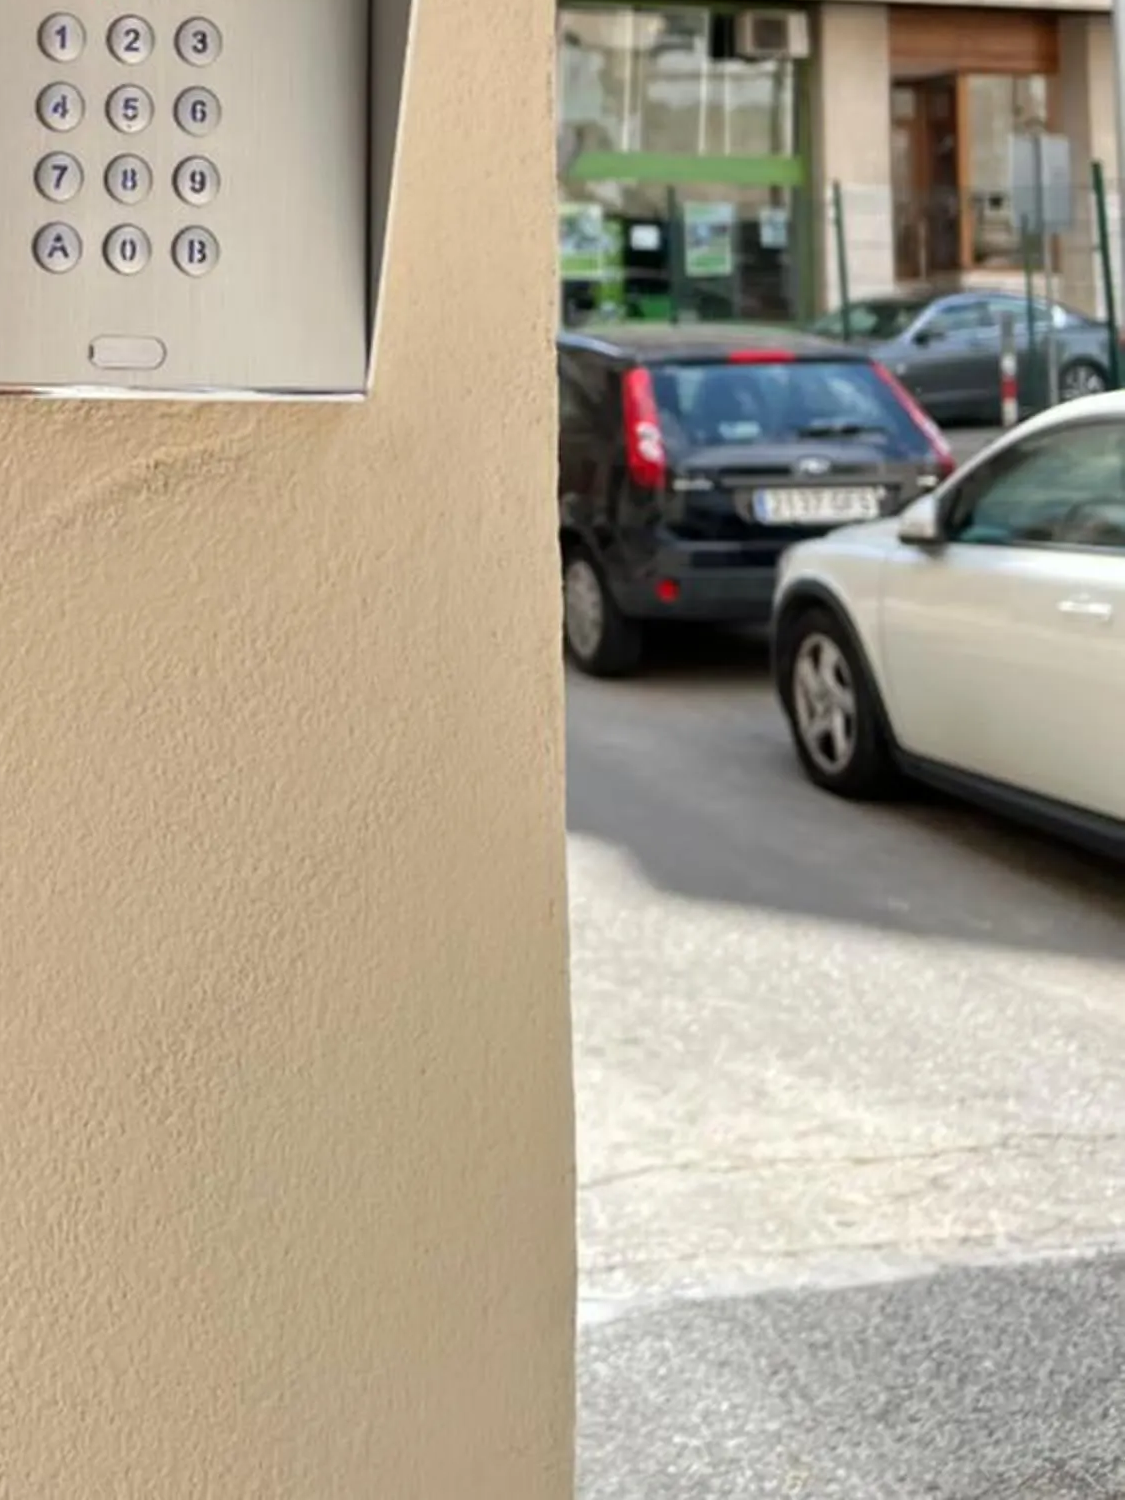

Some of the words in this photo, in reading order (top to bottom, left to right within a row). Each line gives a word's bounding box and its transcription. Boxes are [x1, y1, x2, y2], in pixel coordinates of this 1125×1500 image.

[55, 25, 68, 50] 1
[123, 28, 140, 52] 2
[191, 30, 208, 54] 3
[52, 94, 69, 119] 4
[122, 97, 139, 121] 5
[190, 100, 207, 123] 6
[52, 165, 68, 190] 7
[121, 168, 138, 192] 8
[189, 169, 206, 193] 9
[47, 233, 69, 259] A
[120, 238, 137, 262] 0
[188, 239, 207, 264] B
